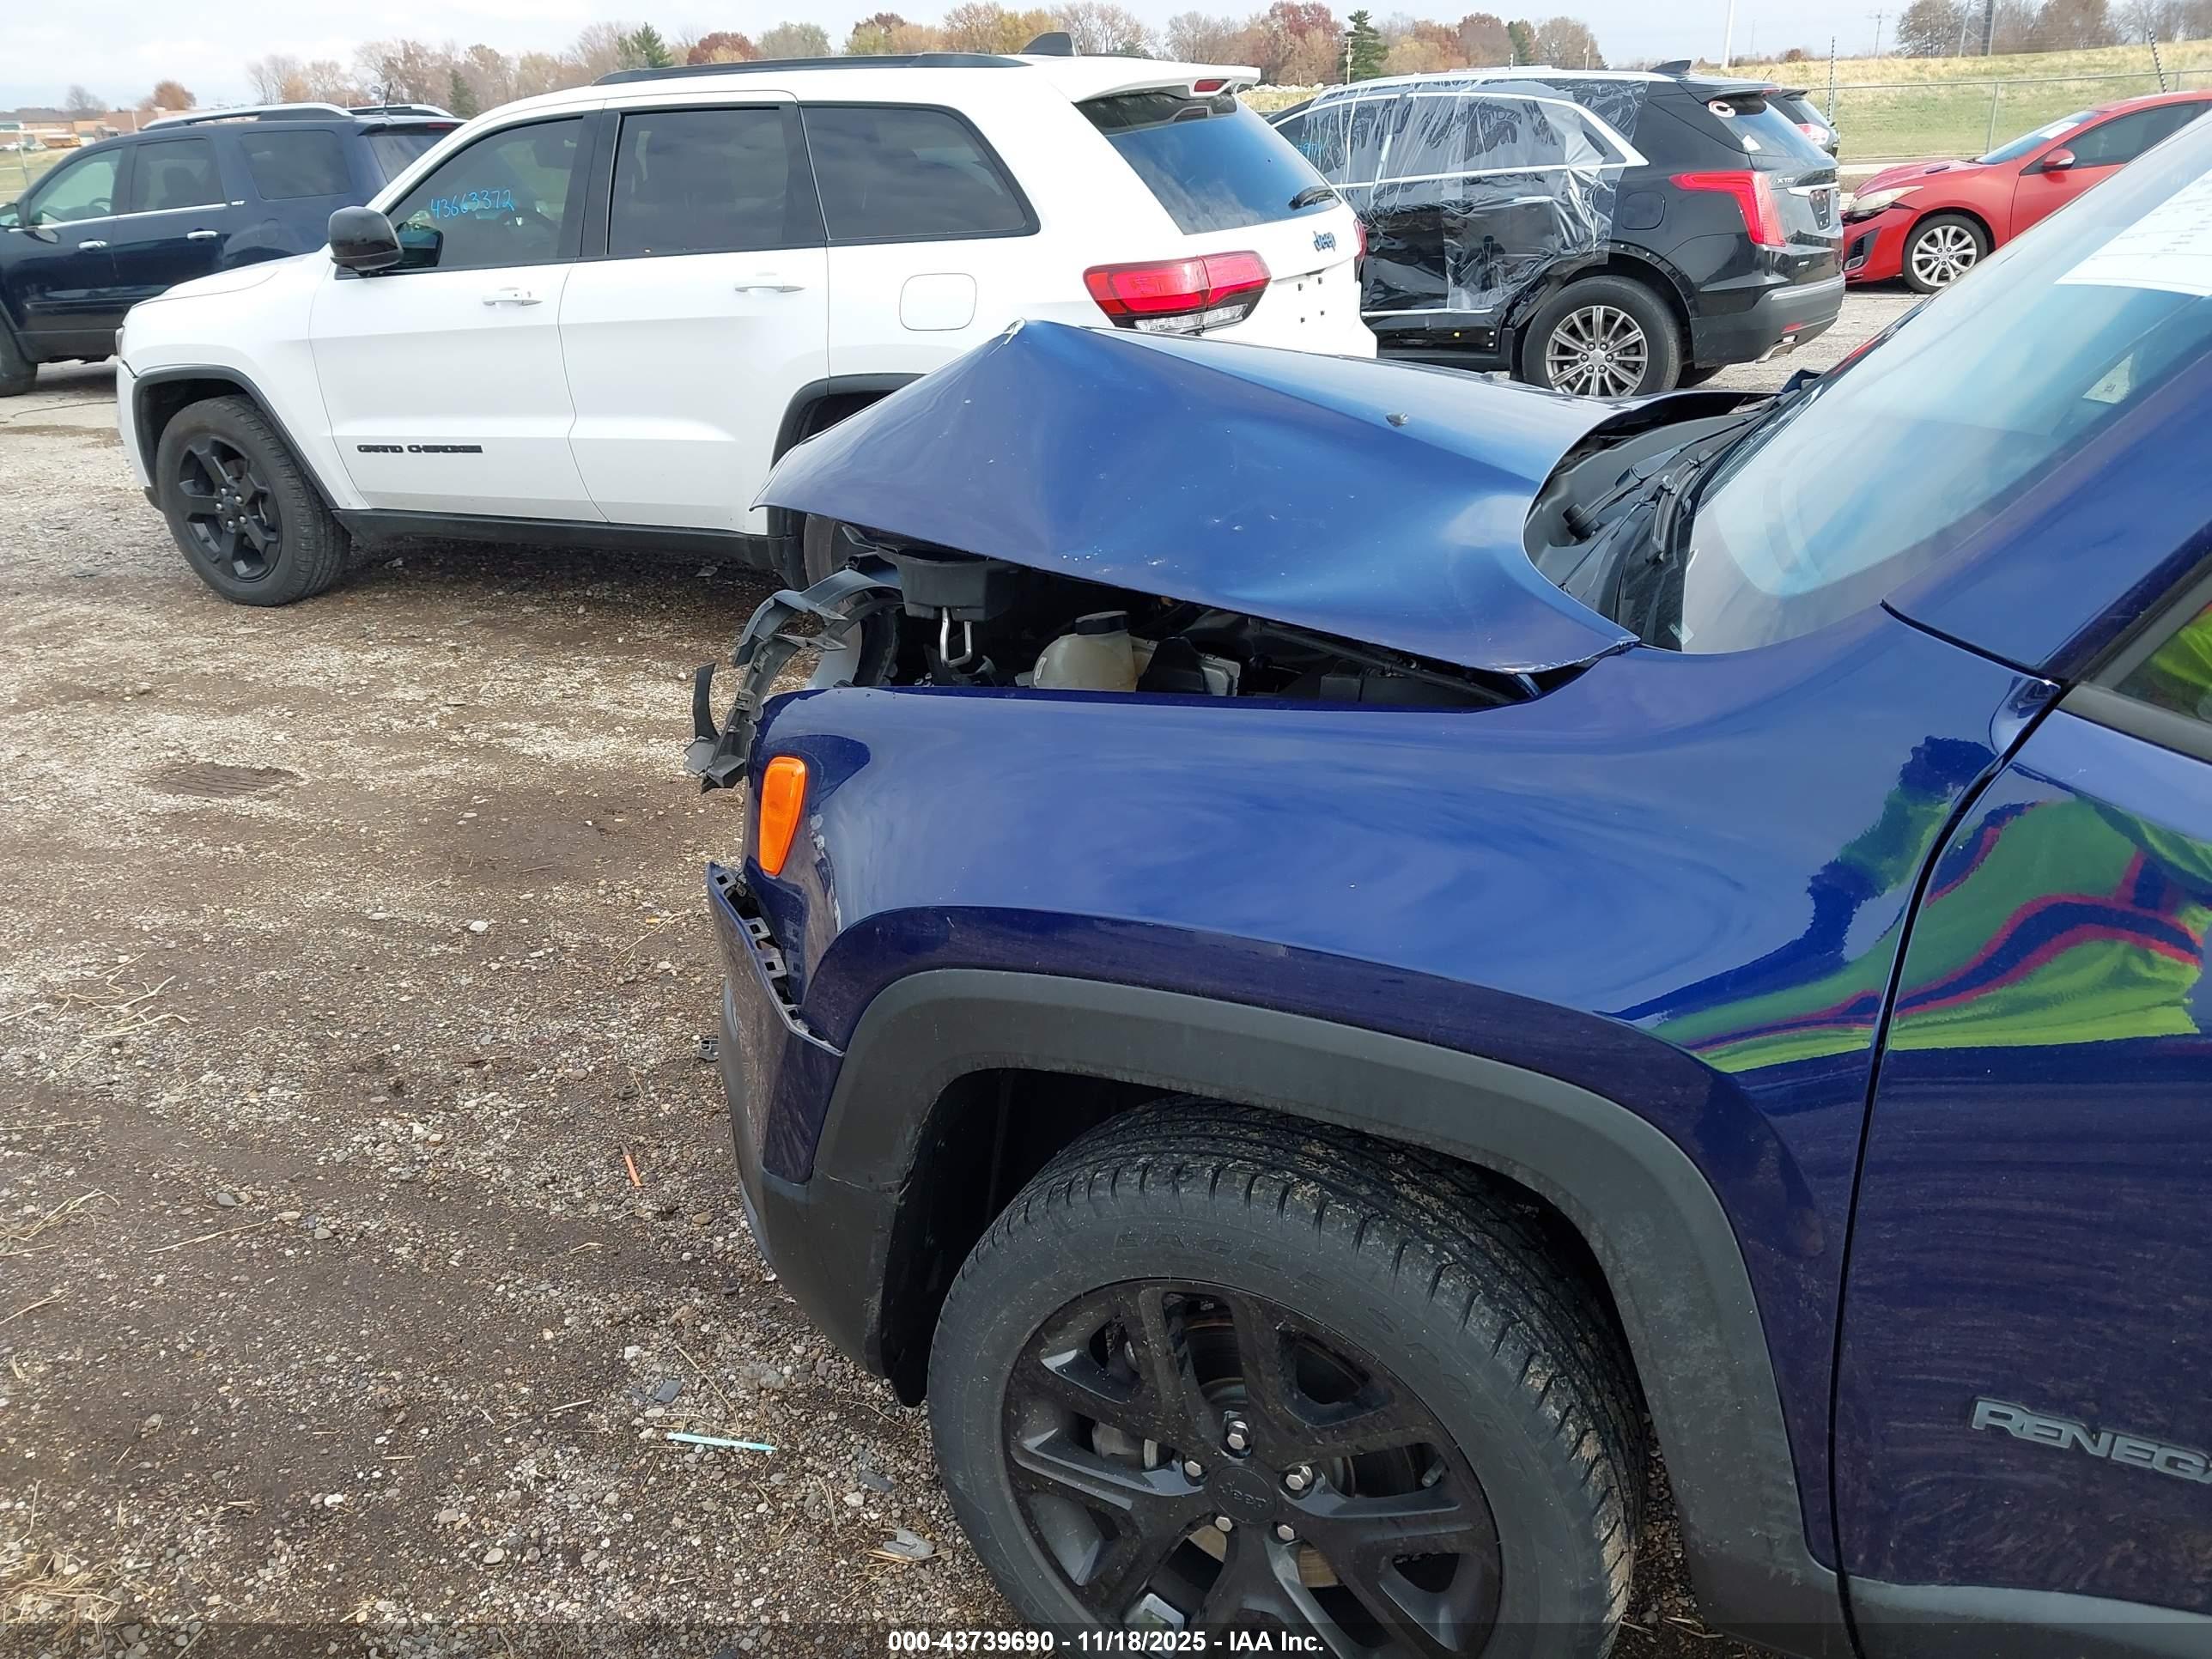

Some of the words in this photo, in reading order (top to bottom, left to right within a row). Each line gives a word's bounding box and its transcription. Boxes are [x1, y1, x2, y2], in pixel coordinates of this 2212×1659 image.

[430, 189, 515, 220] 43663372
[1313, 230, 1337, 252] Jeep
[1114, 1233, 1334, 1294] EAGLE
[1972, 1397, 2212, 1485] RENEG
[1218, 1480, 1271, 1510] Jeep
